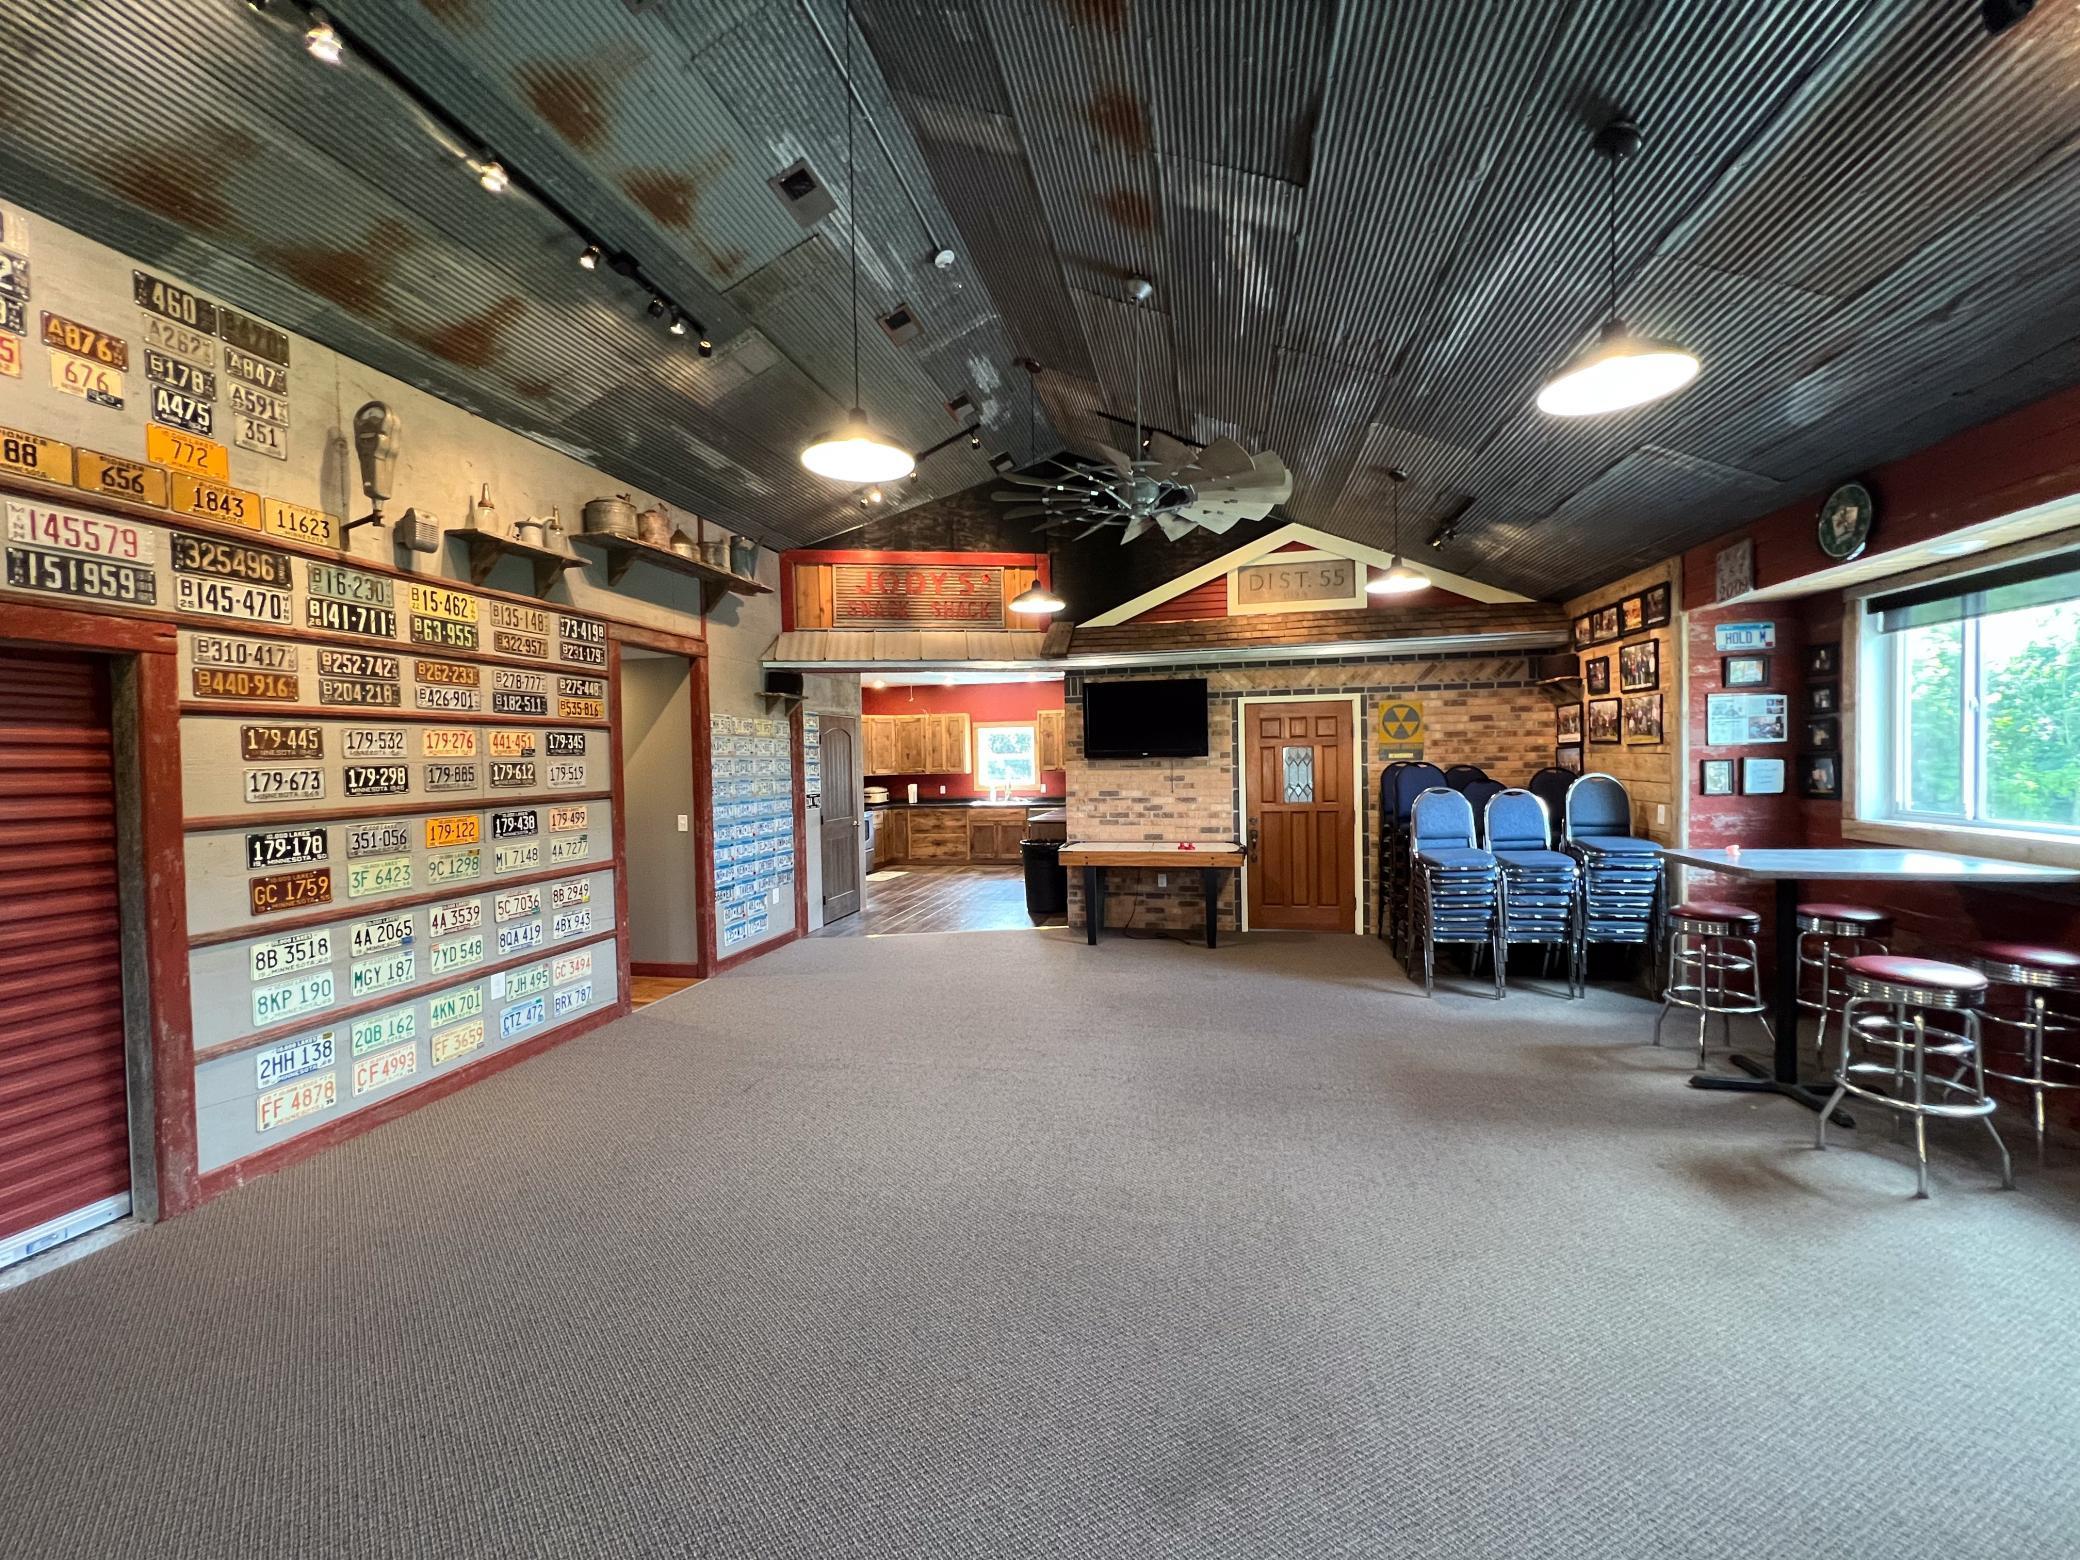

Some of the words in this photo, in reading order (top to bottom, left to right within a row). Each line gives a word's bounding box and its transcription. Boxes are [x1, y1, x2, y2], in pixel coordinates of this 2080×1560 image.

[152, 283, 197, 325] 460
[48, 318, 113, 362] A876
[65, 360, 109, 394] 676
[151, 355, 204, 394] B178
[231, 353, 276, 388] A847
[157, 389, 210, 426] A475
[232, 387, 278, 421] A591
[246, 420, 278, 448] 351
[3, 438, 38, 468] 88
[171, 438, 209, 468] 772
[101, 466, 145, 494] 656
[193, 487, 244, 518] 1843
[29, 509, 138, 558] 145579
[277, 509, 331, 539] 11623
[185, 539, 275, 582] 325496
[28, 552, 136, 600] 151959
[1250, 570, 1313, 592] DIST.
[1319, 568, 1346, 588] 55
[929, 600, 993, 620] SHACK
[247, 728, 318, 750] 179-445
[346, 731, 404, 750] 179-532
[426, 732, 473, 750] 179-276
[492, 733, 533, 750] 441-451
[549, 733, 584, 750] 179-345
[249, 770, 320, 793] 179-673
[348, 767, 406, 788] 179-298
[428, 766, 475, 784] 179-885
[493, 763, 535, 781] 179-612
[289, 830, 311, 838] LAKES
[430, 821, 475, 841] 179-122
[495, 815, 536, 834] 179-438
[254, 835, 323, 861] 179-178
[351, 828, 407, 850] 351-056
[267, 855, 312, 865] MINNESOTA
[428, 860, 445, 878] 9C
[448, 856, 480, 875] 1298
[512, 847, 539, 865] 7148
[351, 869, 370, 889] 3F
[375, 864, 411, 886] 6423
[254, 884, 278, 905] GC
[285, 876, 329, 901] 1759
[567, 883, 590, 901] 2949
[432, 912, 447, 930] 4A
[450, 905, 481, 926] 3539
[497, 899, 511, 916] 5C
[513, 894, 540, 912] 7036
[354, 928, 373, 947] 4A
[376, 919, 413, 944] 2065
[522, 924, 541, 941] 419
[574, 912, 591, 929] 943
[255, 949, 278, 971] 8B
[284, 937, 329, 964] 3518
[433, 945, 457, 967] 7YD
[460, 940, 482, 960] 548
[271, 960, 315, 974] MINNESOTA
[354, 965, 382, 990] MGY
[387, 957, 413, 981] 187
[529, 969, 548, 988] 495
[257, 989, 293, 1015] 8KP
[300, 977, 332, 1004] 190
[432, 998, 455, 1021] 4KN
[459, 991, 481, 1013] 701
[574, 985, 592, 1003] 787
[387, 1014, 414, 1038] 162
[453, 1025, 483, 1051] 3659
[260, 1050, 295, 1080] 2HH
[301, 1039, 333, 1066] 138
[262, 1096, 284, 1124] FF
[291, 1080, 335, 1111] 4878
